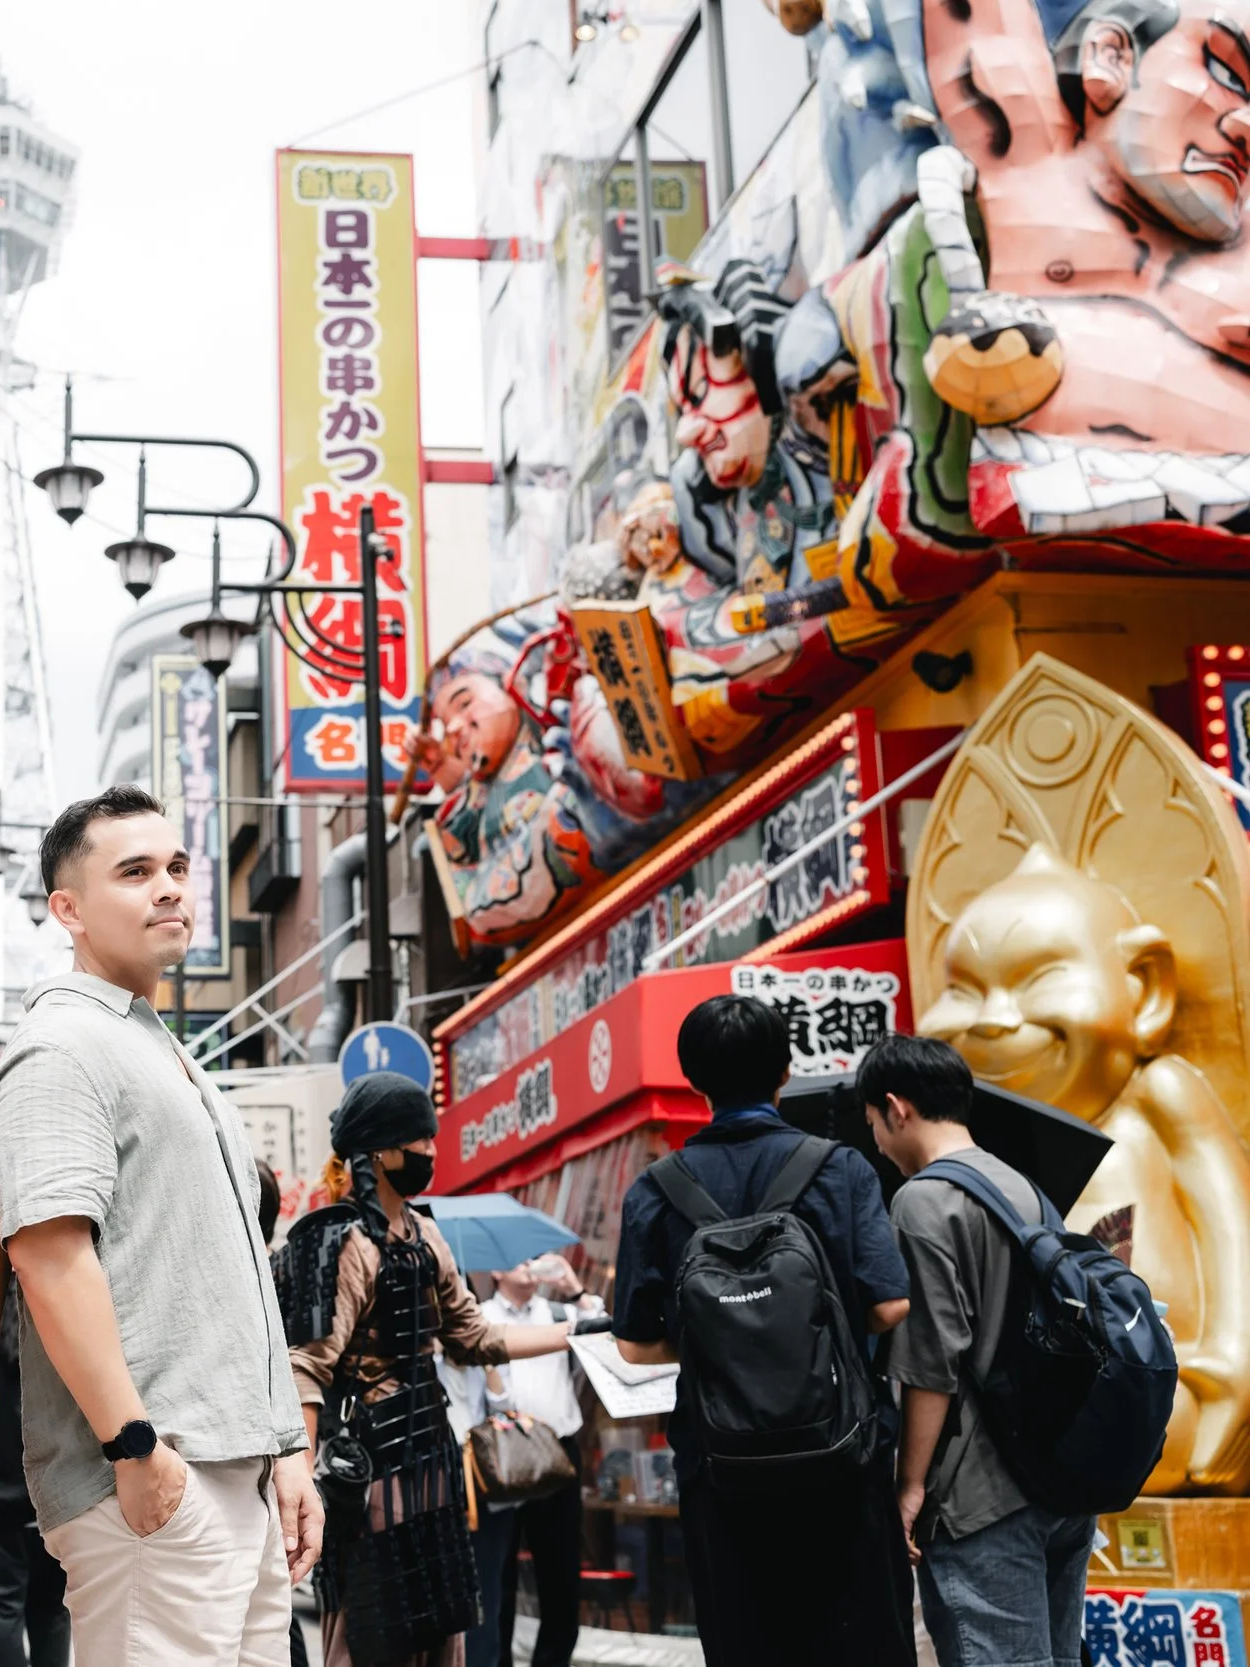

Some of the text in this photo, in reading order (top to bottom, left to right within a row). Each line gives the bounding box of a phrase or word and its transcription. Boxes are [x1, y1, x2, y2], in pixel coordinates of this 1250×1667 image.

[321, 210, 379, 483] 日本一の串かつ
[738, 971, 894, 993] 日本一の串かつ
